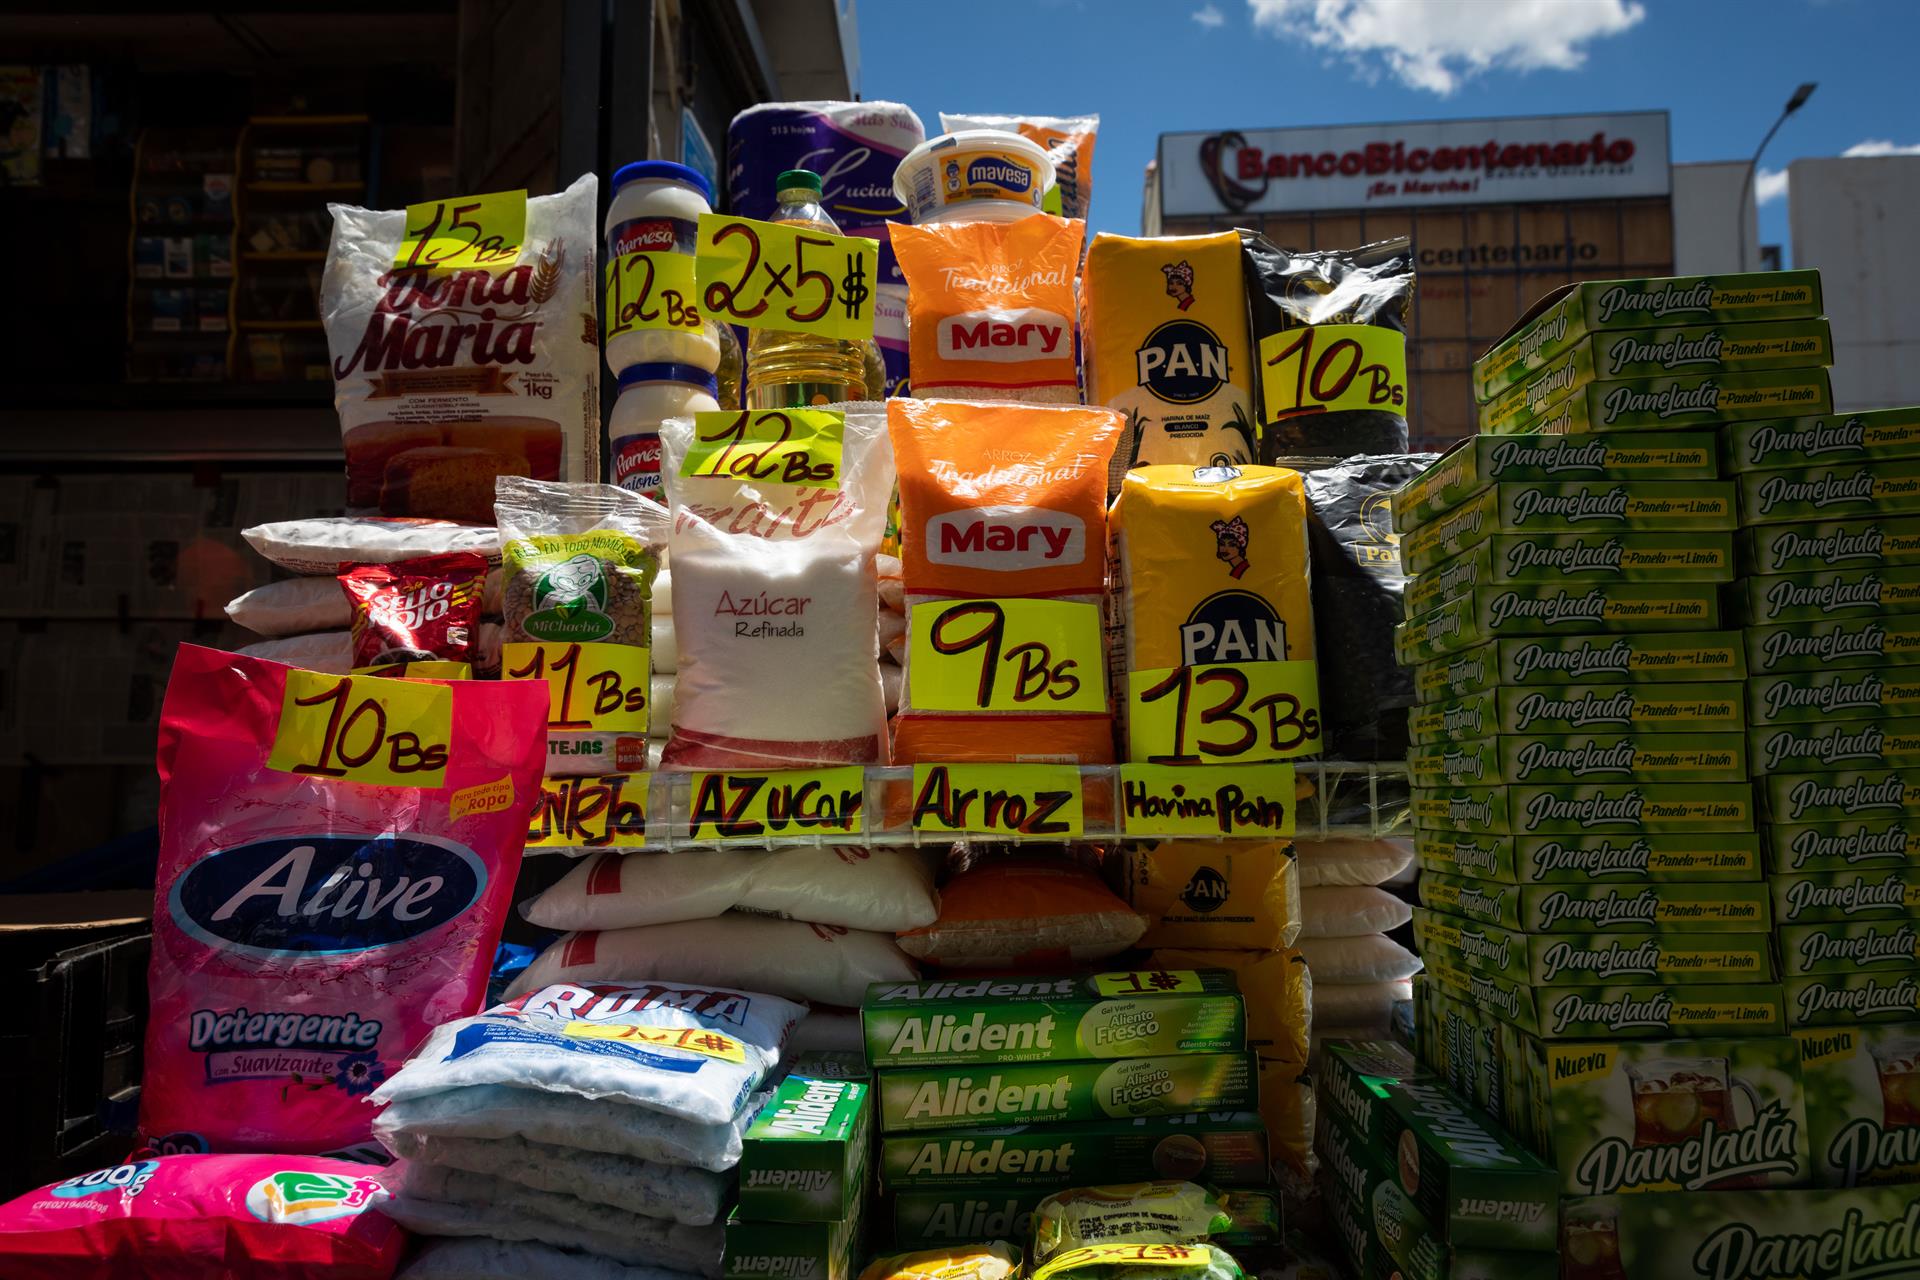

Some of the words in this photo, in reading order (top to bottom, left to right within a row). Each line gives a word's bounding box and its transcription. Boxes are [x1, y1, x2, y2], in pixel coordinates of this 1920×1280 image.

[1237, 133, 1636, 181] BancoBicentenario
[972, 166, 1029, 187] mavesa
[392, 203, 482, 271] 15
[472, 236, 517, 264] Bs
[1419, 237, 1598, 266] centenario
[984, 261, 1022, 273] ARROZ
[939, 264, 1068, 299] Tradicional
[606, 255, 660, 338] 12
[660, 290, 701, 327] Bs
[1720, 292, 1756, 306] Panela
[1775, 289, 1806, 302] Limón
[951, 320, 1062, 353] Mary
[1729, 341, 1765, 356] Panela
[1784, 340, 1816, 352] Limón
[1267, 328, 1363, 419] 10
[1359, 364, 1404, 406] Bs
[523, 382, 553, 399] 1kg
[1726, 389, 1762, 405] Panela
[1782, 388, 1814, 401] Limón
[690, 410, 779, 479] 12
[781, 452, 835, 483] Bs
[983, 449, 1032, 463] ARROZ
[617, 449, 662, 476] Prames
[1612, 451, 1649, 465] Panela
[1669, 451, 1701, 464] Limón
[1634, 501, 1670, 514] Panela
[1689, 501, 1721, 513] Limón
[544, 543, 560, 554] EN
[563, 540, 590, 552] TODO
[941, 521, 1072, 559] Mary
[1630, 552, 1667, 565] Panela
[1685, 552, 1718, 564] Limón
[374, 582, 453, 612] SELLO
[714, 590, 811, 617] Azúcar
[1612, 602, 1650, 616] Panela
[1669, 602, 1701, 615] Limón
[735, 621, 804, 639] Refinada
[930, 601, 1005, 708] 9
[1004, 641, 1081, 702] Bs
[1639, 652, 1676, 666] Panela
[1695, 651, 1729, 665] Limón
[509, 643, 592, 729] 11
[587, 670, 646, 716] Bs
[1140, 666, 1258, 766] 13
[1249, 693, 1321, 751] Bs
[1640, 703, 1678, 717] Panela
[1697, 703, 1730, 716] Limón
[292, 677, 387, 777] 10
[386, 732, 449, 773] Bs
[546, 740, 603, 755] TEJAS
[1641, 754, 1679, 767] Panela
[1698, 753, 1731, 766] Limón
[493, 783, 511, 793] tipo
[468, 794, 507, 811] Ropa
[1216, 784, 1285, 834] Pan
[1650, 804, 1687, 818] Panela
[1706, 803, 1740, 817] Limón
[1656, 854, 1695, 868] Panela
[1713, 853, 1746, 867] Limón
[210, 846, 444, 922] Alive
[1665, 905, 1703, 918] Panela
[1721, 904, 1754, 917] Limón
[1666, 955, 1703, 968] Panela
[1721, 954, 1754, 968] Limón
[879, 979, 1077, 1001] Alident
[515, 983, 752, 1027] ROMA
[1101, 1006, 1113, 1015] Gel
[1115, 1003, 1136, 1013] Verde
[1678, 1007, 1717, 1020] Panela
[1735, 1006, 1769, 1019] Limón
[191, 1008, 380, 1049] Detergente
[1110, 1011, 1154, 1027] Aliento
[888, 1012, 1056, 1055] Alident
[1096, 1021, 1160, 1046] Fresco
[1208, 1040, 1231, 1048] Fresco
[998, 1053, 1040, 1062] PRO-WHITE
[1801, 1032, 1852, 1062] Nueva
[215, 1068, 229, 1076] con
[231, 1053, 333, 1074] Suavizante
[1130, 1062, 1151, 1072] Verde
[1554, 1053, 1607, 1081] Nueva
[1126, 1070, 1169, 1087] Aliento
[904, 1074, 1072, 1120] Alident
[1111, 1080, 1175, 1105] Fresco
[770, 1080, 848, 1135] Alident
[1015, 1114, 1057, 1124] PRO-WHITE
[908, 1140, 1075, 1176] Alident
[748, 1169, 832, 1193] Alident
[1461, 1197, 1547, 1224] Alident
[733, 1255, 816, 1278] Alident
